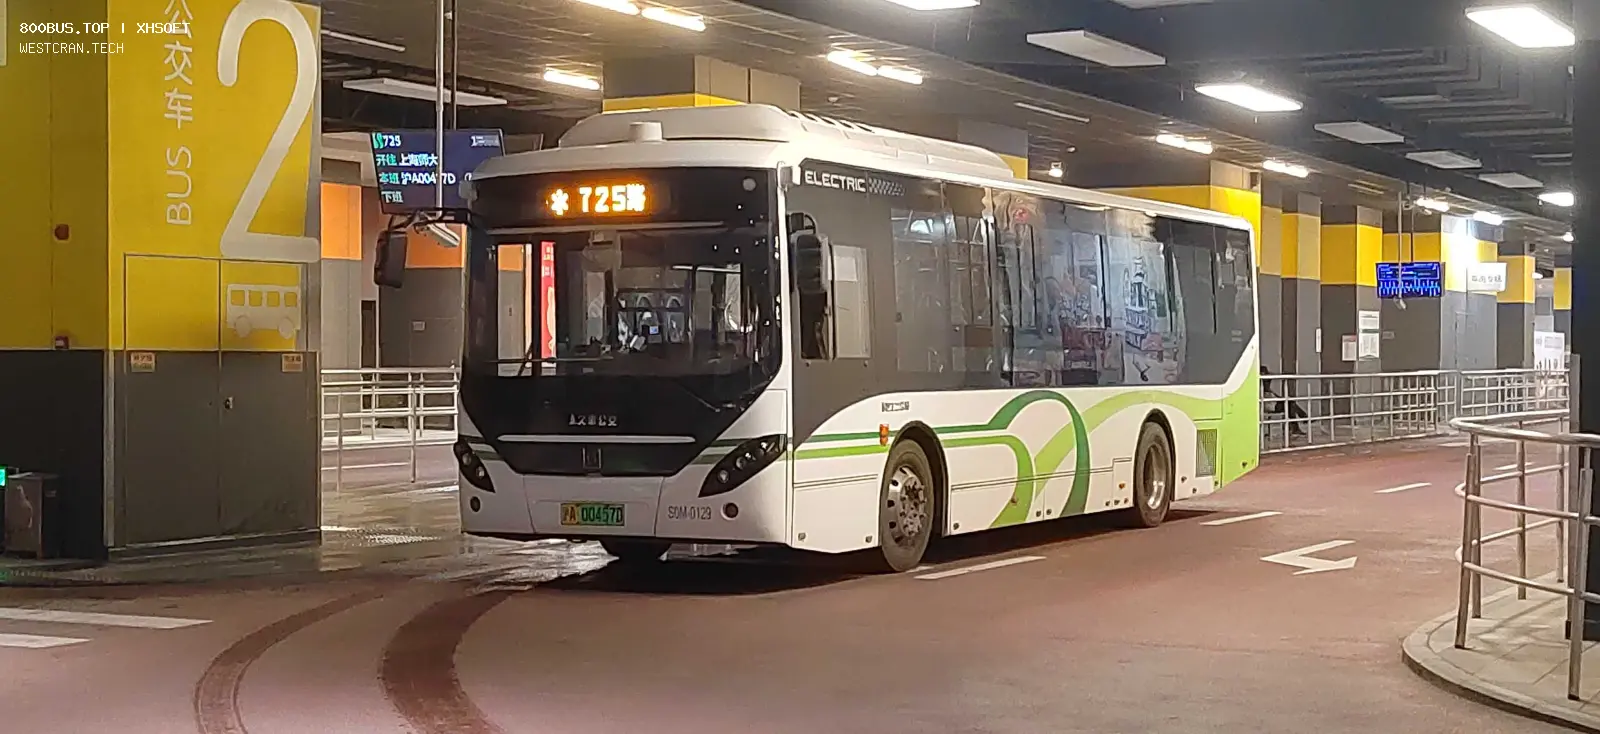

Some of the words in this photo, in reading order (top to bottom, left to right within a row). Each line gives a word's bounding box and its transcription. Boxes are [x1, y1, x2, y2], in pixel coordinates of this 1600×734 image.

[163, 0, 194, 130] 公交车
[217, 0, 321, 263] 2
[382, 134, 402, 147] 725
[375, 153, 398, 167] 开往
[166, 145, 193, 226] BUS
[401, 171, 457, 186] 沪A0047D
[804, 169, 867, 193] ELECTRIC
